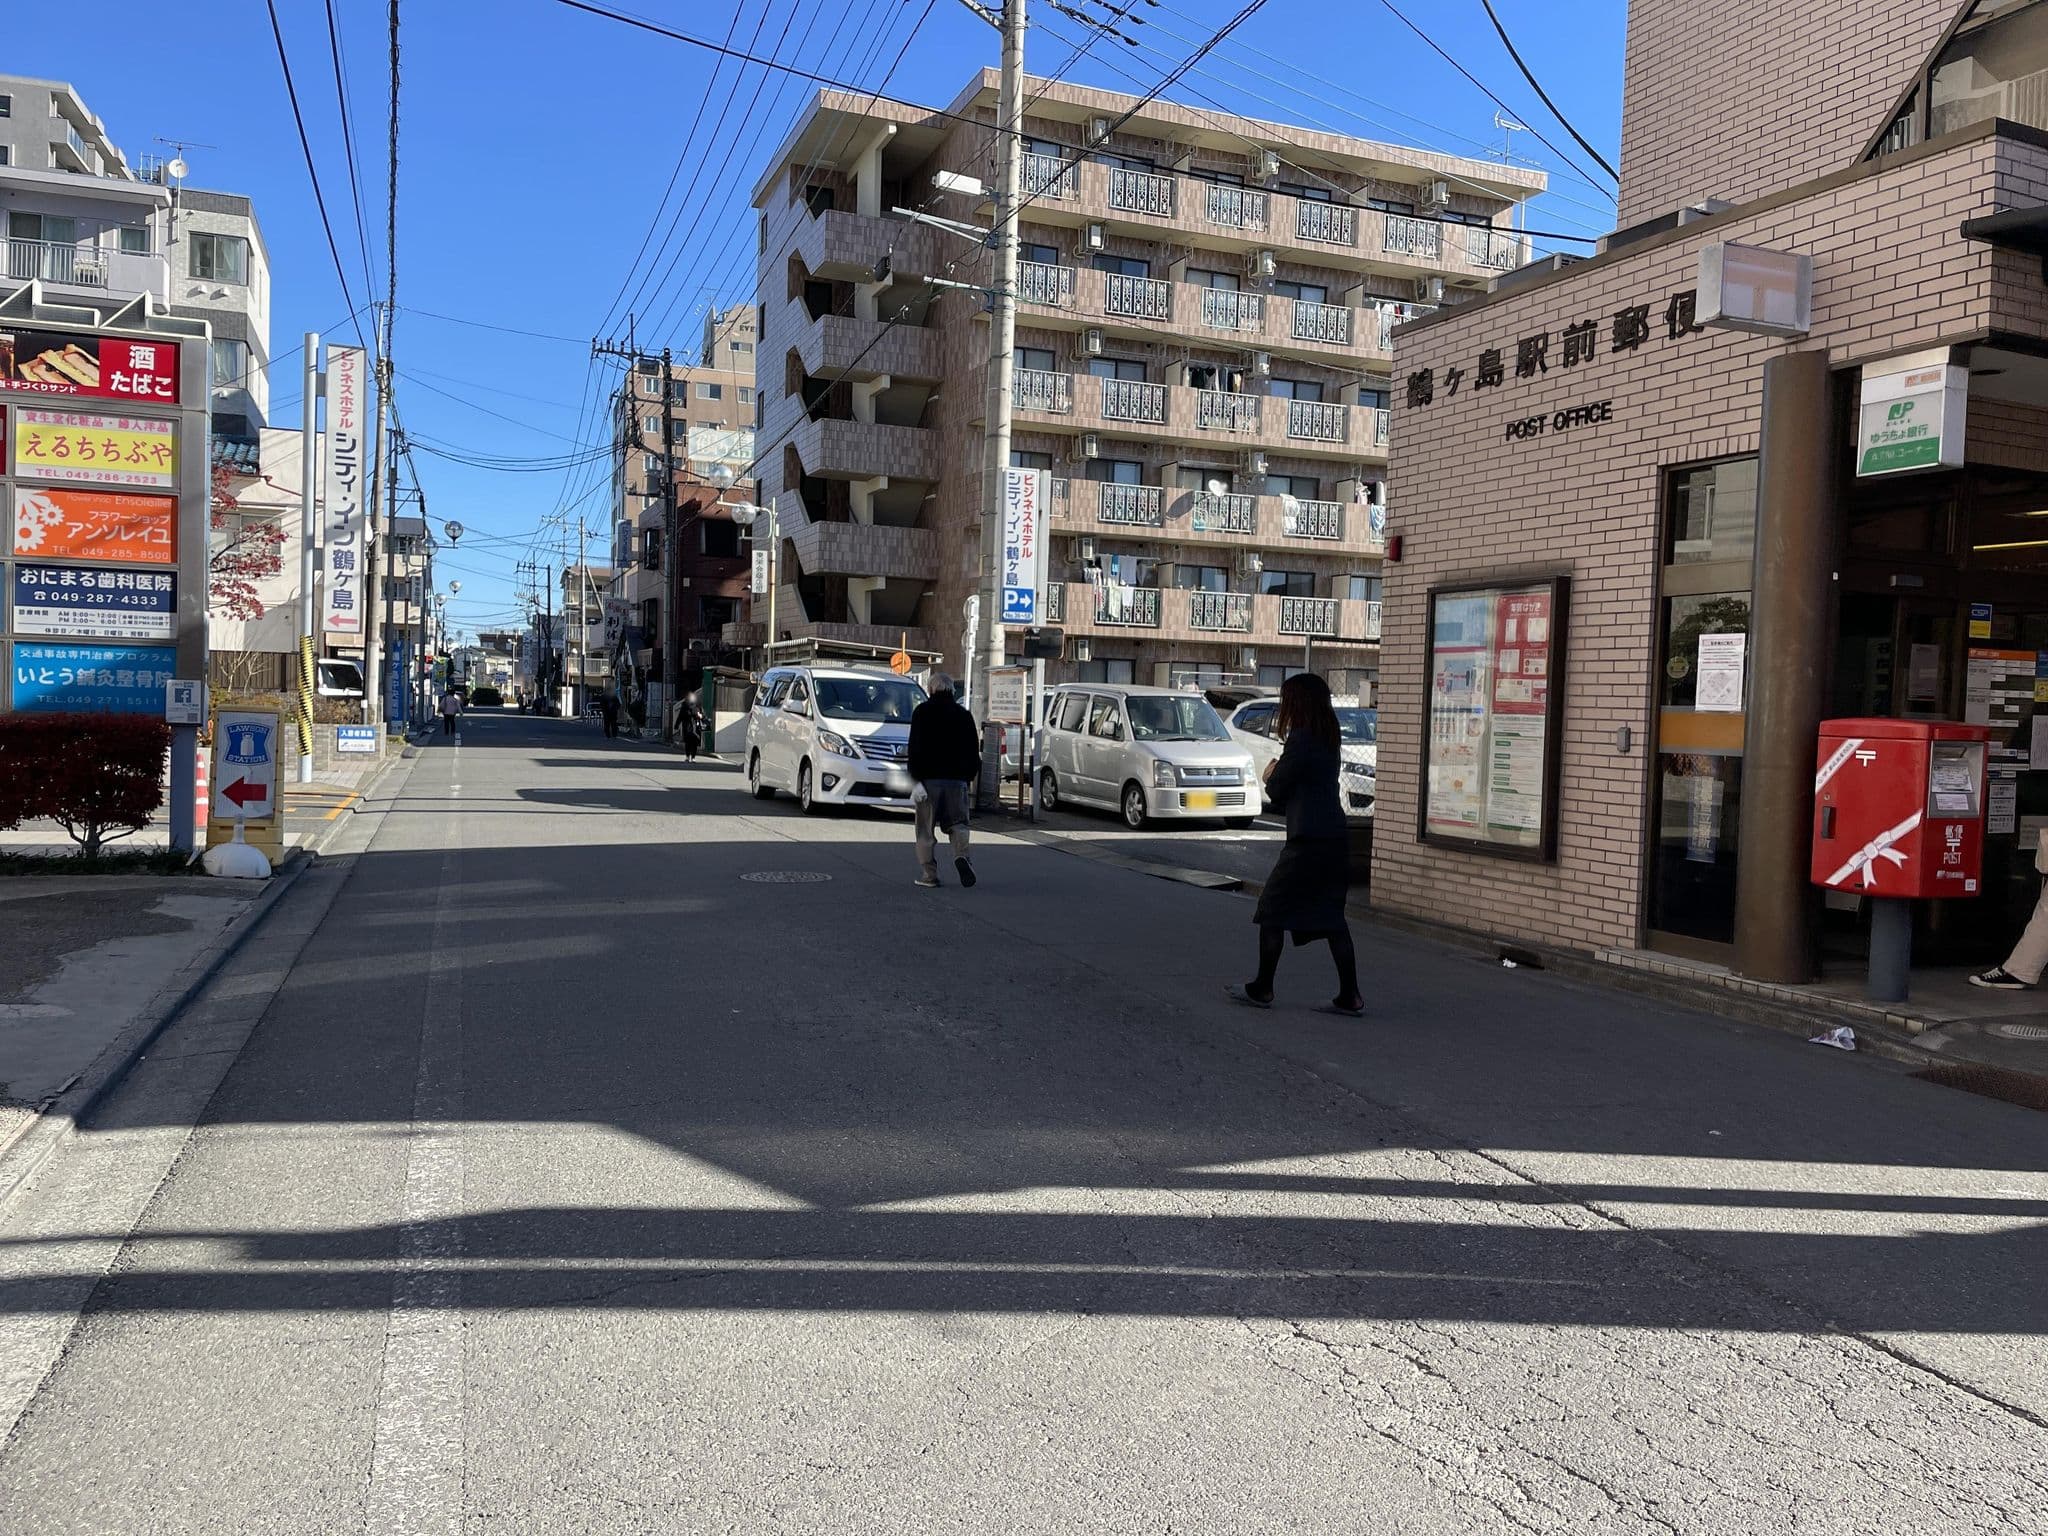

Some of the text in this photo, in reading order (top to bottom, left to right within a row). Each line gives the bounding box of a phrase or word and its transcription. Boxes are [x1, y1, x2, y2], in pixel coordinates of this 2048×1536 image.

[129, 345, 155, 371] 酒
[110, 371, 172, 396] たばこ
[339, 351, 354, 429] ビジネスホテル
[1506, 400, 1613, 441] POST OFFICE
[1870, 424, 1929, 443] ゆうちょ銀行
[25, 432, 172, 466] えるちちぶや
[88, 511, 171, 525] フラワーショップ
[1022, 474, 1034, 558] ビジネスホテル
[66, 522, 171, 544] アンソレイユ
[52, 545, 73, 555] TEL
[20, 568, 172, 591] おにまる歯科医院
[51, 592, 158, 605] 049-287-4333
[1004, 590, 1018, 610] P
[19, 649, 172, 662] 交通事故専門治療プログラム
[229, 725, 268, 734] LAWSON
[227, 754, 266, 763] STATION
[1943, 852, 1961, 865] POST
